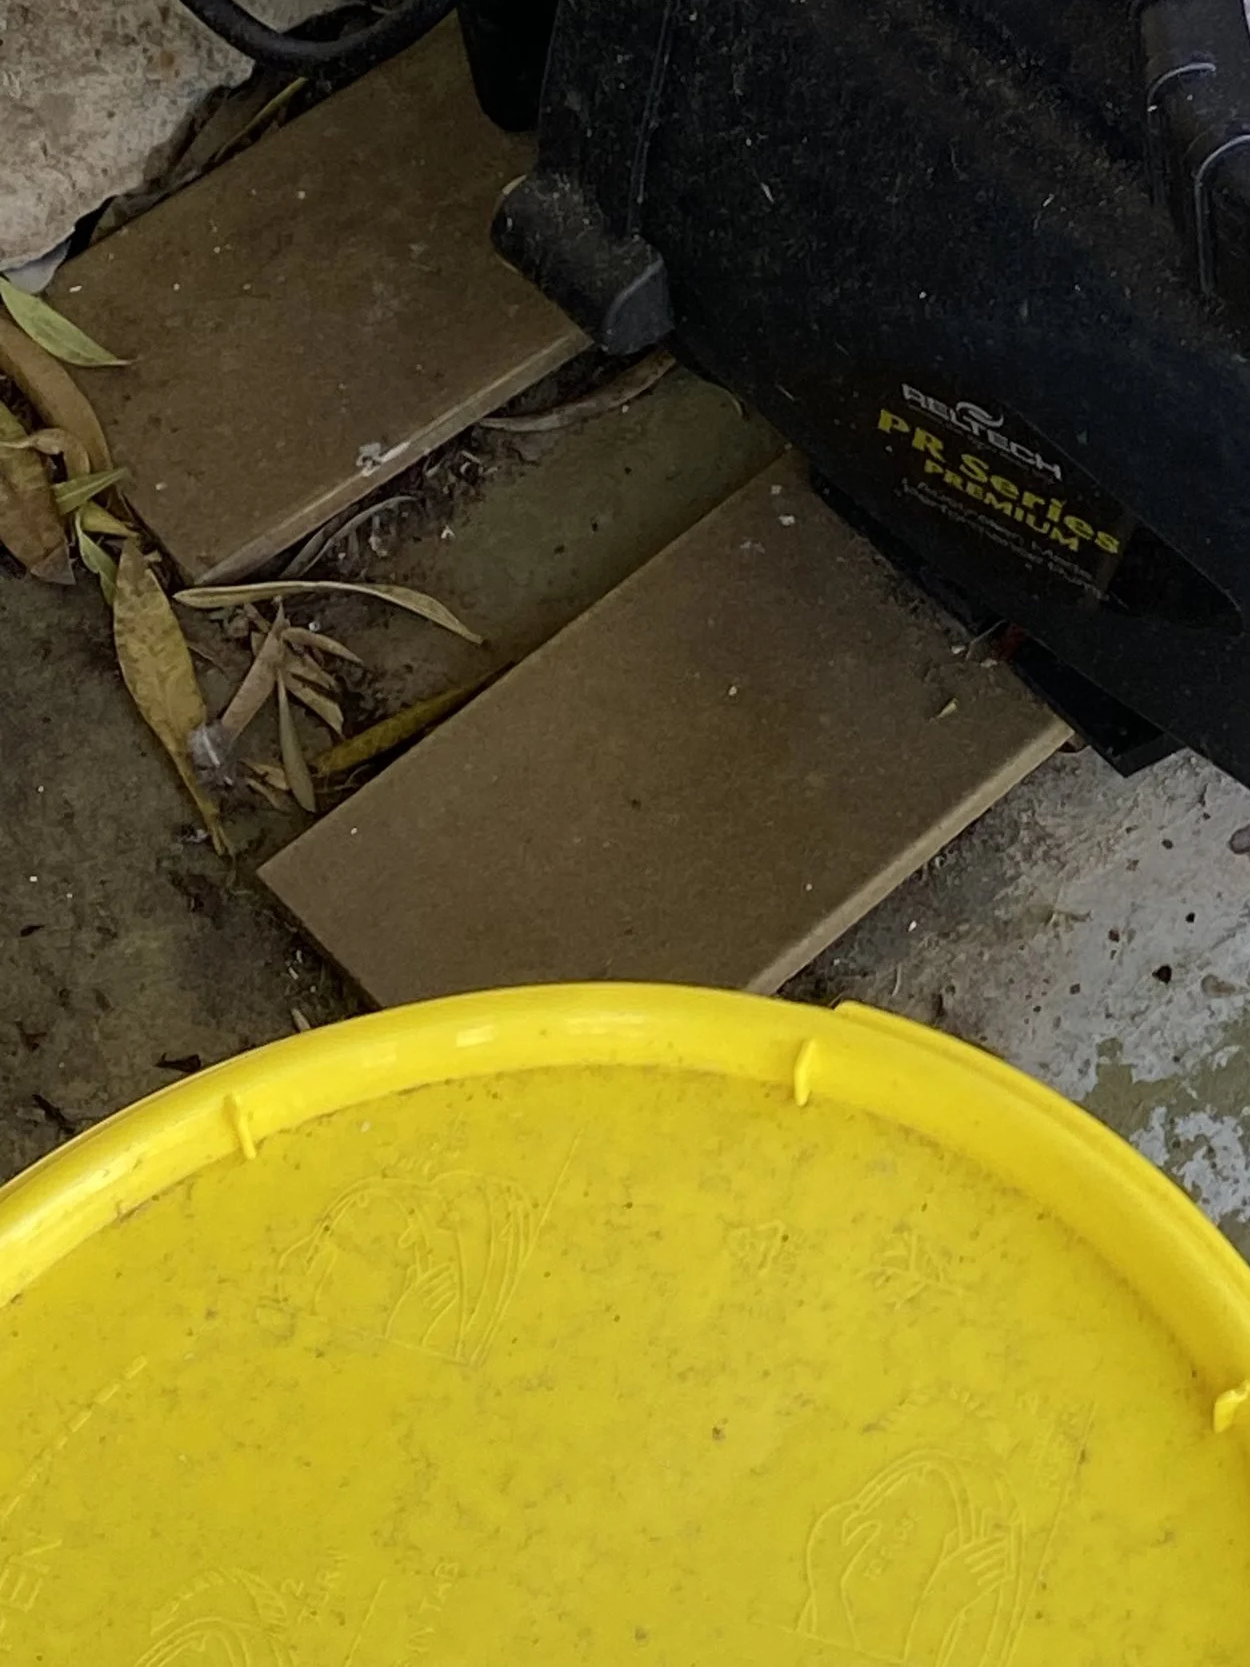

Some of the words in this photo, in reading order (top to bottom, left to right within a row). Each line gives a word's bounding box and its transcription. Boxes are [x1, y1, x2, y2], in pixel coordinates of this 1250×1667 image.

[877, 408, 949, 463] PR
[959, 452, 1121, 555] Series
[900, 382, 1063, 482] RELTECH
[924, 458, 1081, 553] PREMIUM
